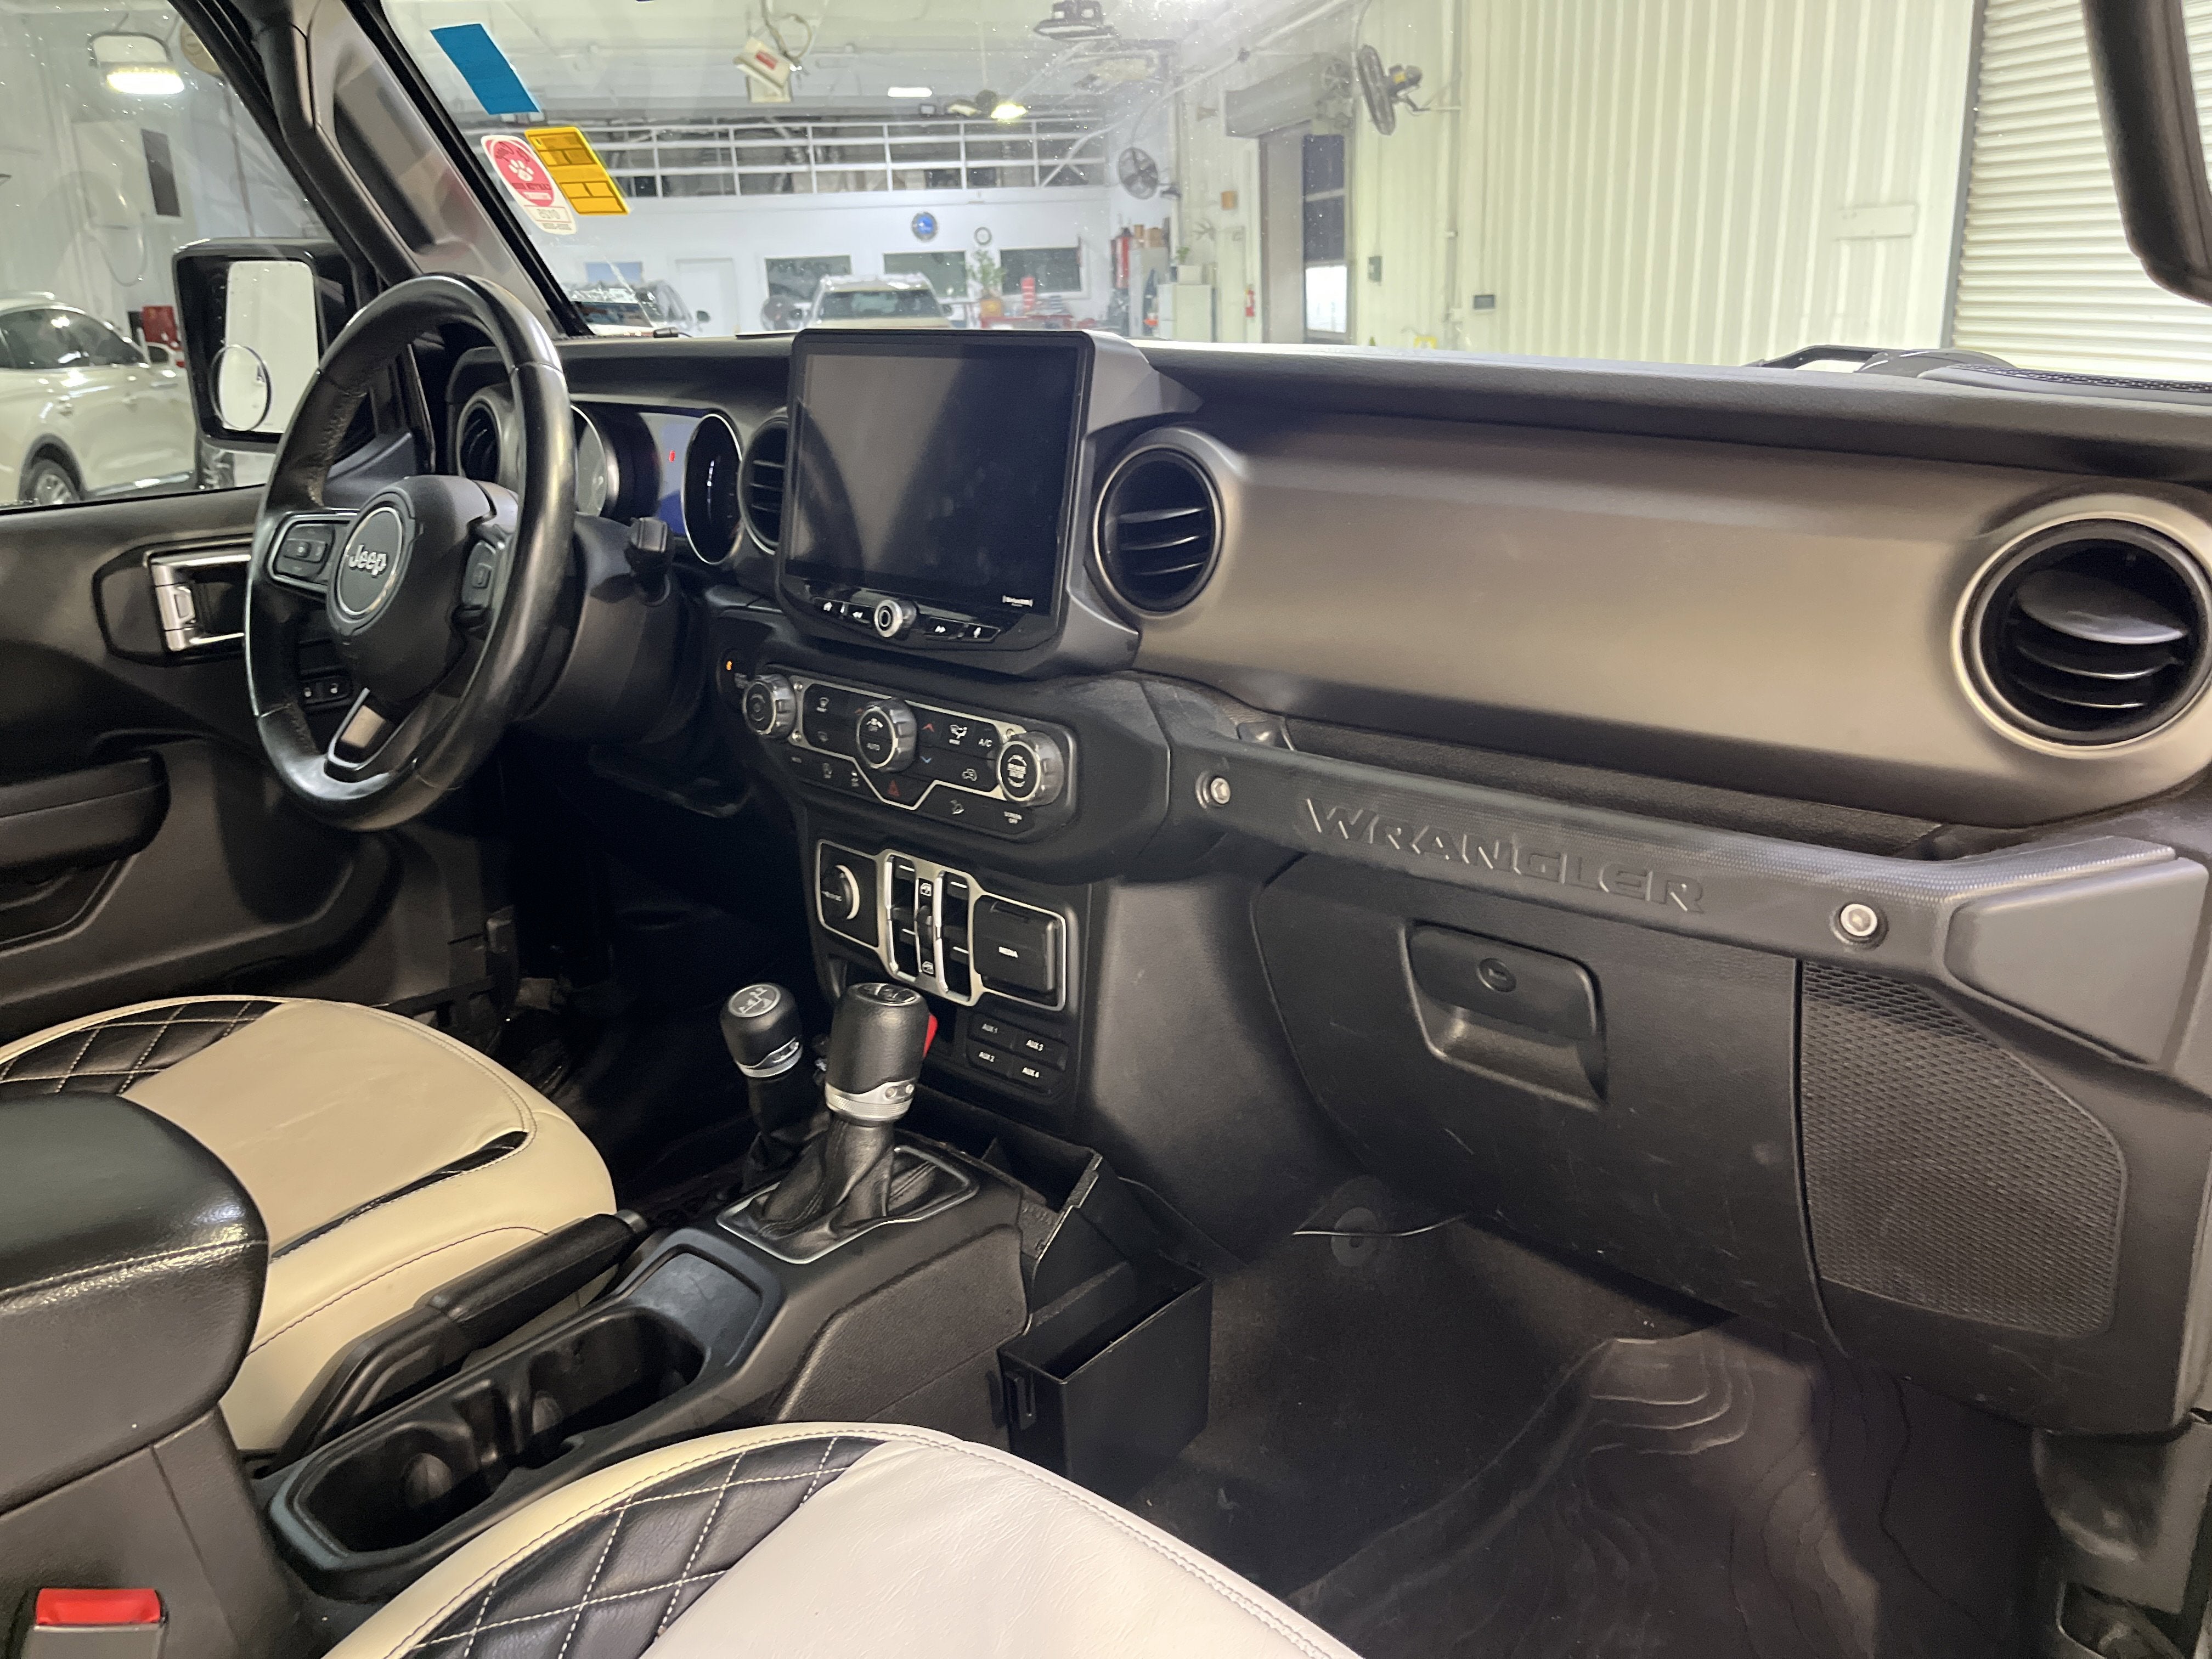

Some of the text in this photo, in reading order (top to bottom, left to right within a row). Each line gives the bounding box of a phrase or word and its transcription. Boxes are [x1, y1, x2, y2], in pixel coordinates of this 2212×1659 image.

[348, 544, 387, 575] Jeep
[978, 738, 992, 747] A/C
[1304, 798, 1704, 914] WRANGLER
[981, 1023, 995, 1032] AUX
[1025, 1040, 1039, 1049] AUX
[978, 1051, 991, 1060] AUX
[1022, 1067, 1035, 1076] AUX
